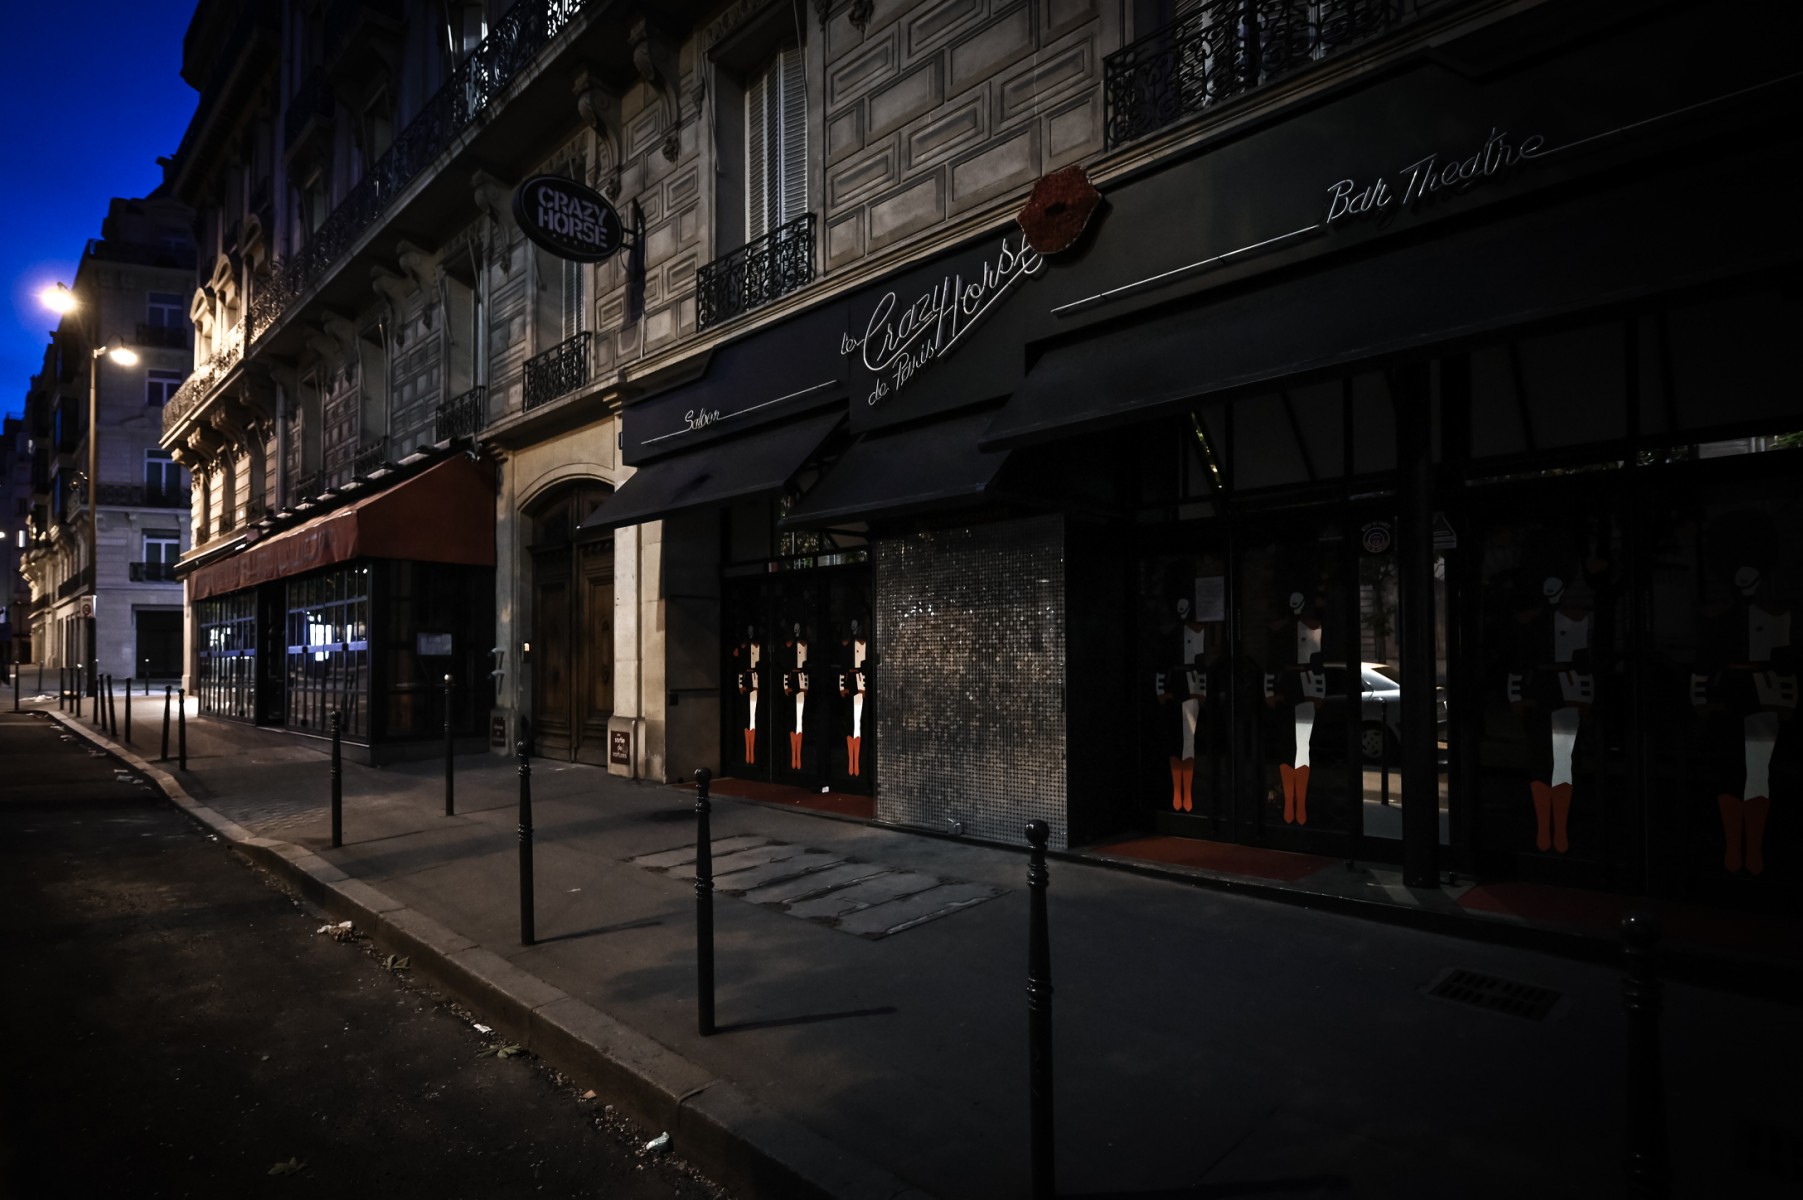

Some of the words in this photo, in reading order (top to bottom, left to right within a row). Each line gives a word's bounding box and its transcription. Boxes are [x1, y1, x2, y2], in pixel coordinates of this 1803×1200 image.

[536, 185, 609, 226] CRAZY
[1327, 177, 1392, 224] Bar
[537, 205, 609, 249] HORSE
[863, 291, 950, 371] Crazy
[936, 234, 1044, 350] Horse
[868, 378, 890, 406] de
[892, 338, 936, 391] Paris
